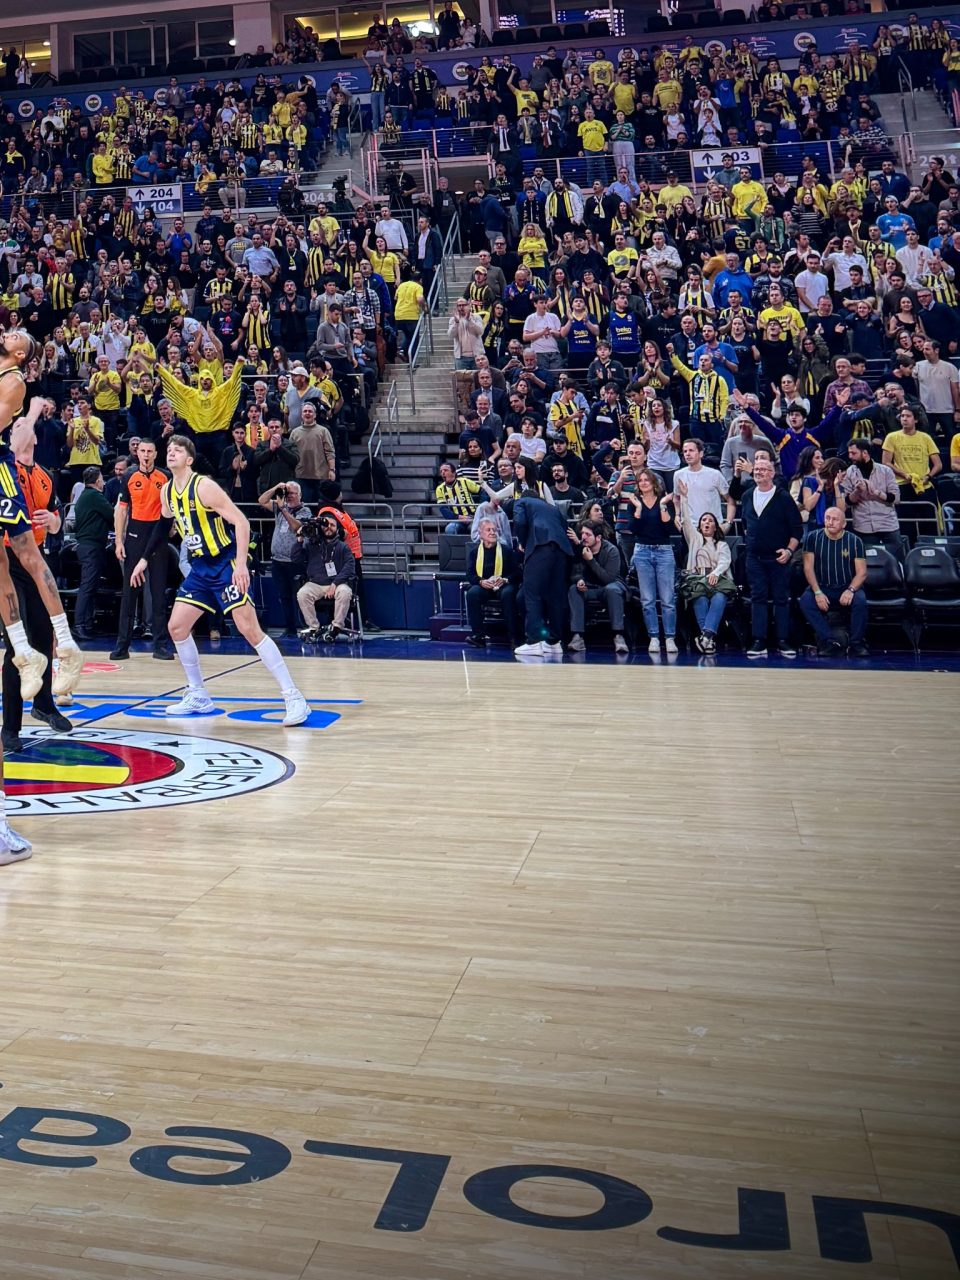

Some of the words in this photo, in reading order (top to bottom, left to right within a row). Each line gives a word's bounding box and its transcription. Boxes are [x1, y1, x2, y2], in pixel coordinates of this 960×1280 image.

[150, 188, 173, 198] 204
[303, 193, 325, 203] 204
[151, 202, 174, 212] 104
[225, 584, 240, 602] 13
